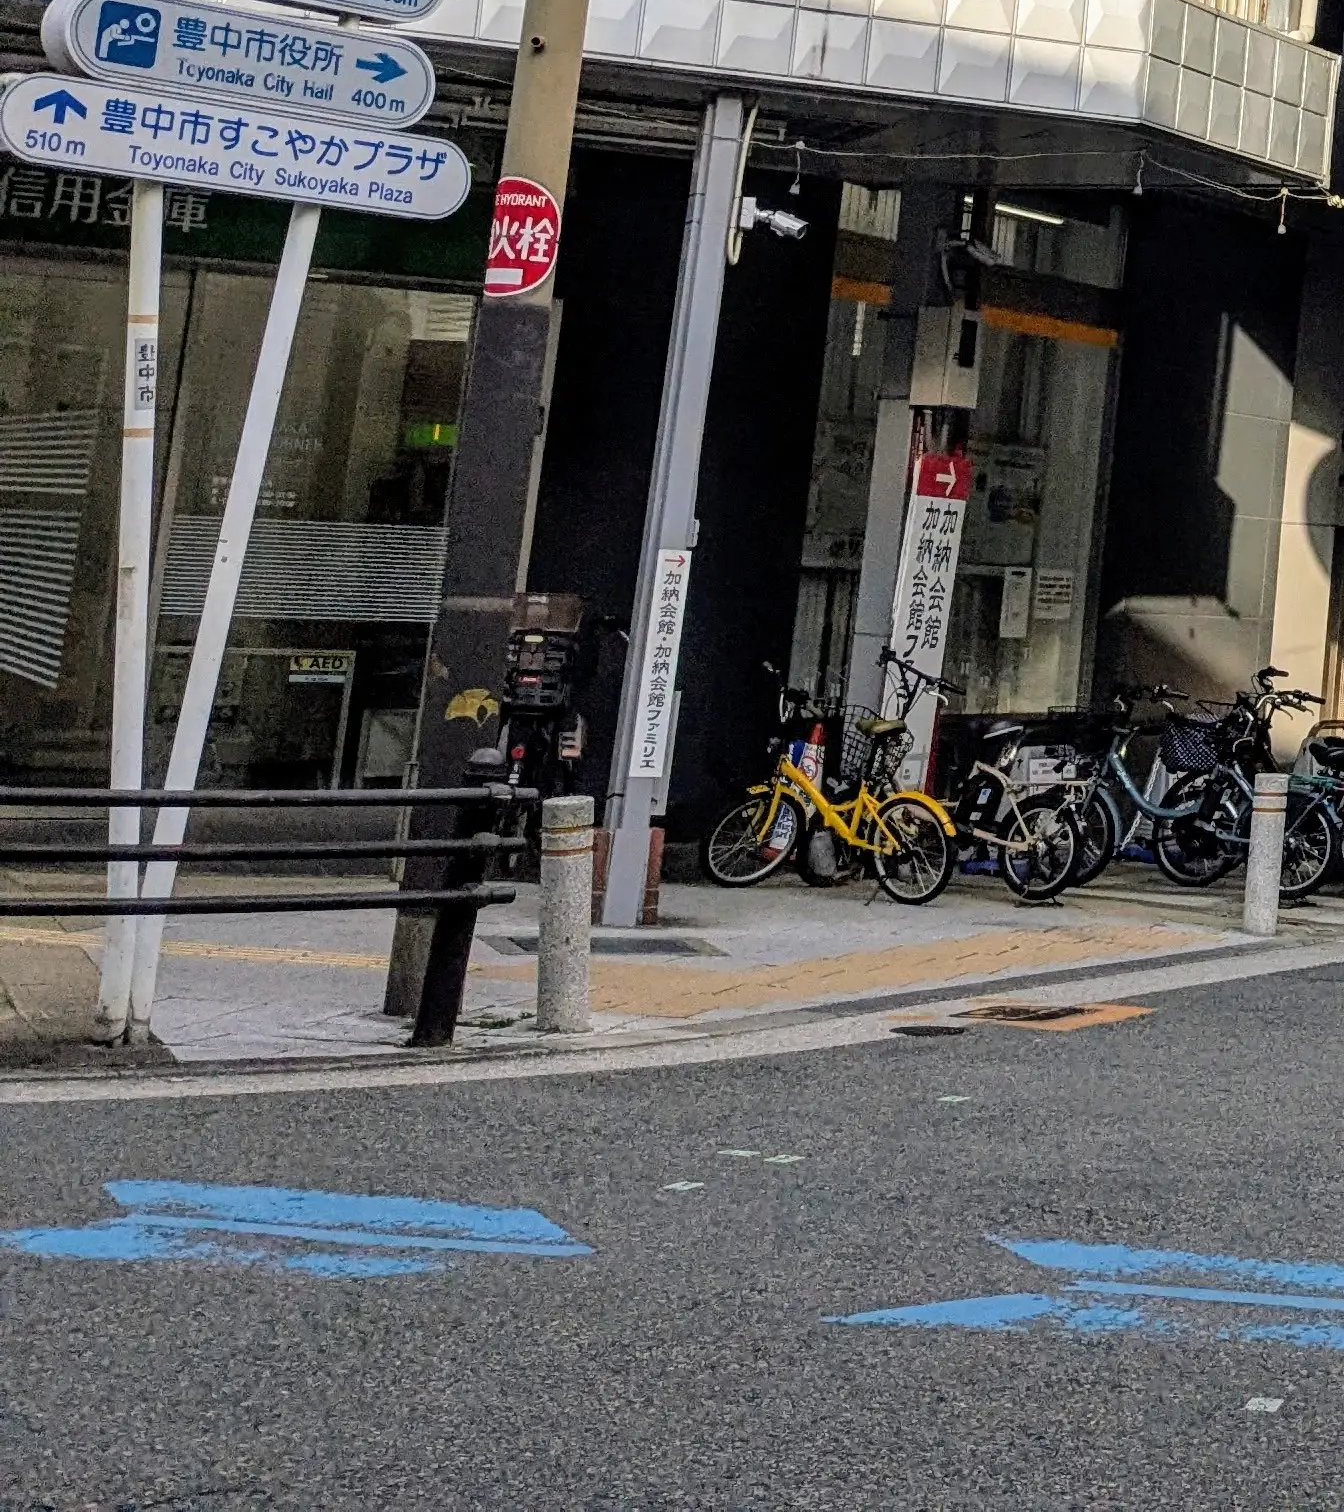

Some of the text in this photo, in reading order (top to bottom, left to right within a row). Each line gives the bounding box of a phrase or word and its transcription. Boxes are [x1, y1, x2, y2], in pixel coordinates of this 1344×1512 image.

[173, 15, 343, 76] 豊中市役所
[176, 57, 335, 103] Toyonaka City Hall
[25, 129, 61, 153] 510
[100, 97, 447, 183] 豊中市すこやかプラザ
[129, 144, 414, 206] Toyonaka City Sukoyaka Plaza
[488, 215, 555, 263] 火栓
[920, 503, 959, 650] 加納会館
[308, 656, 344, 670] AED
